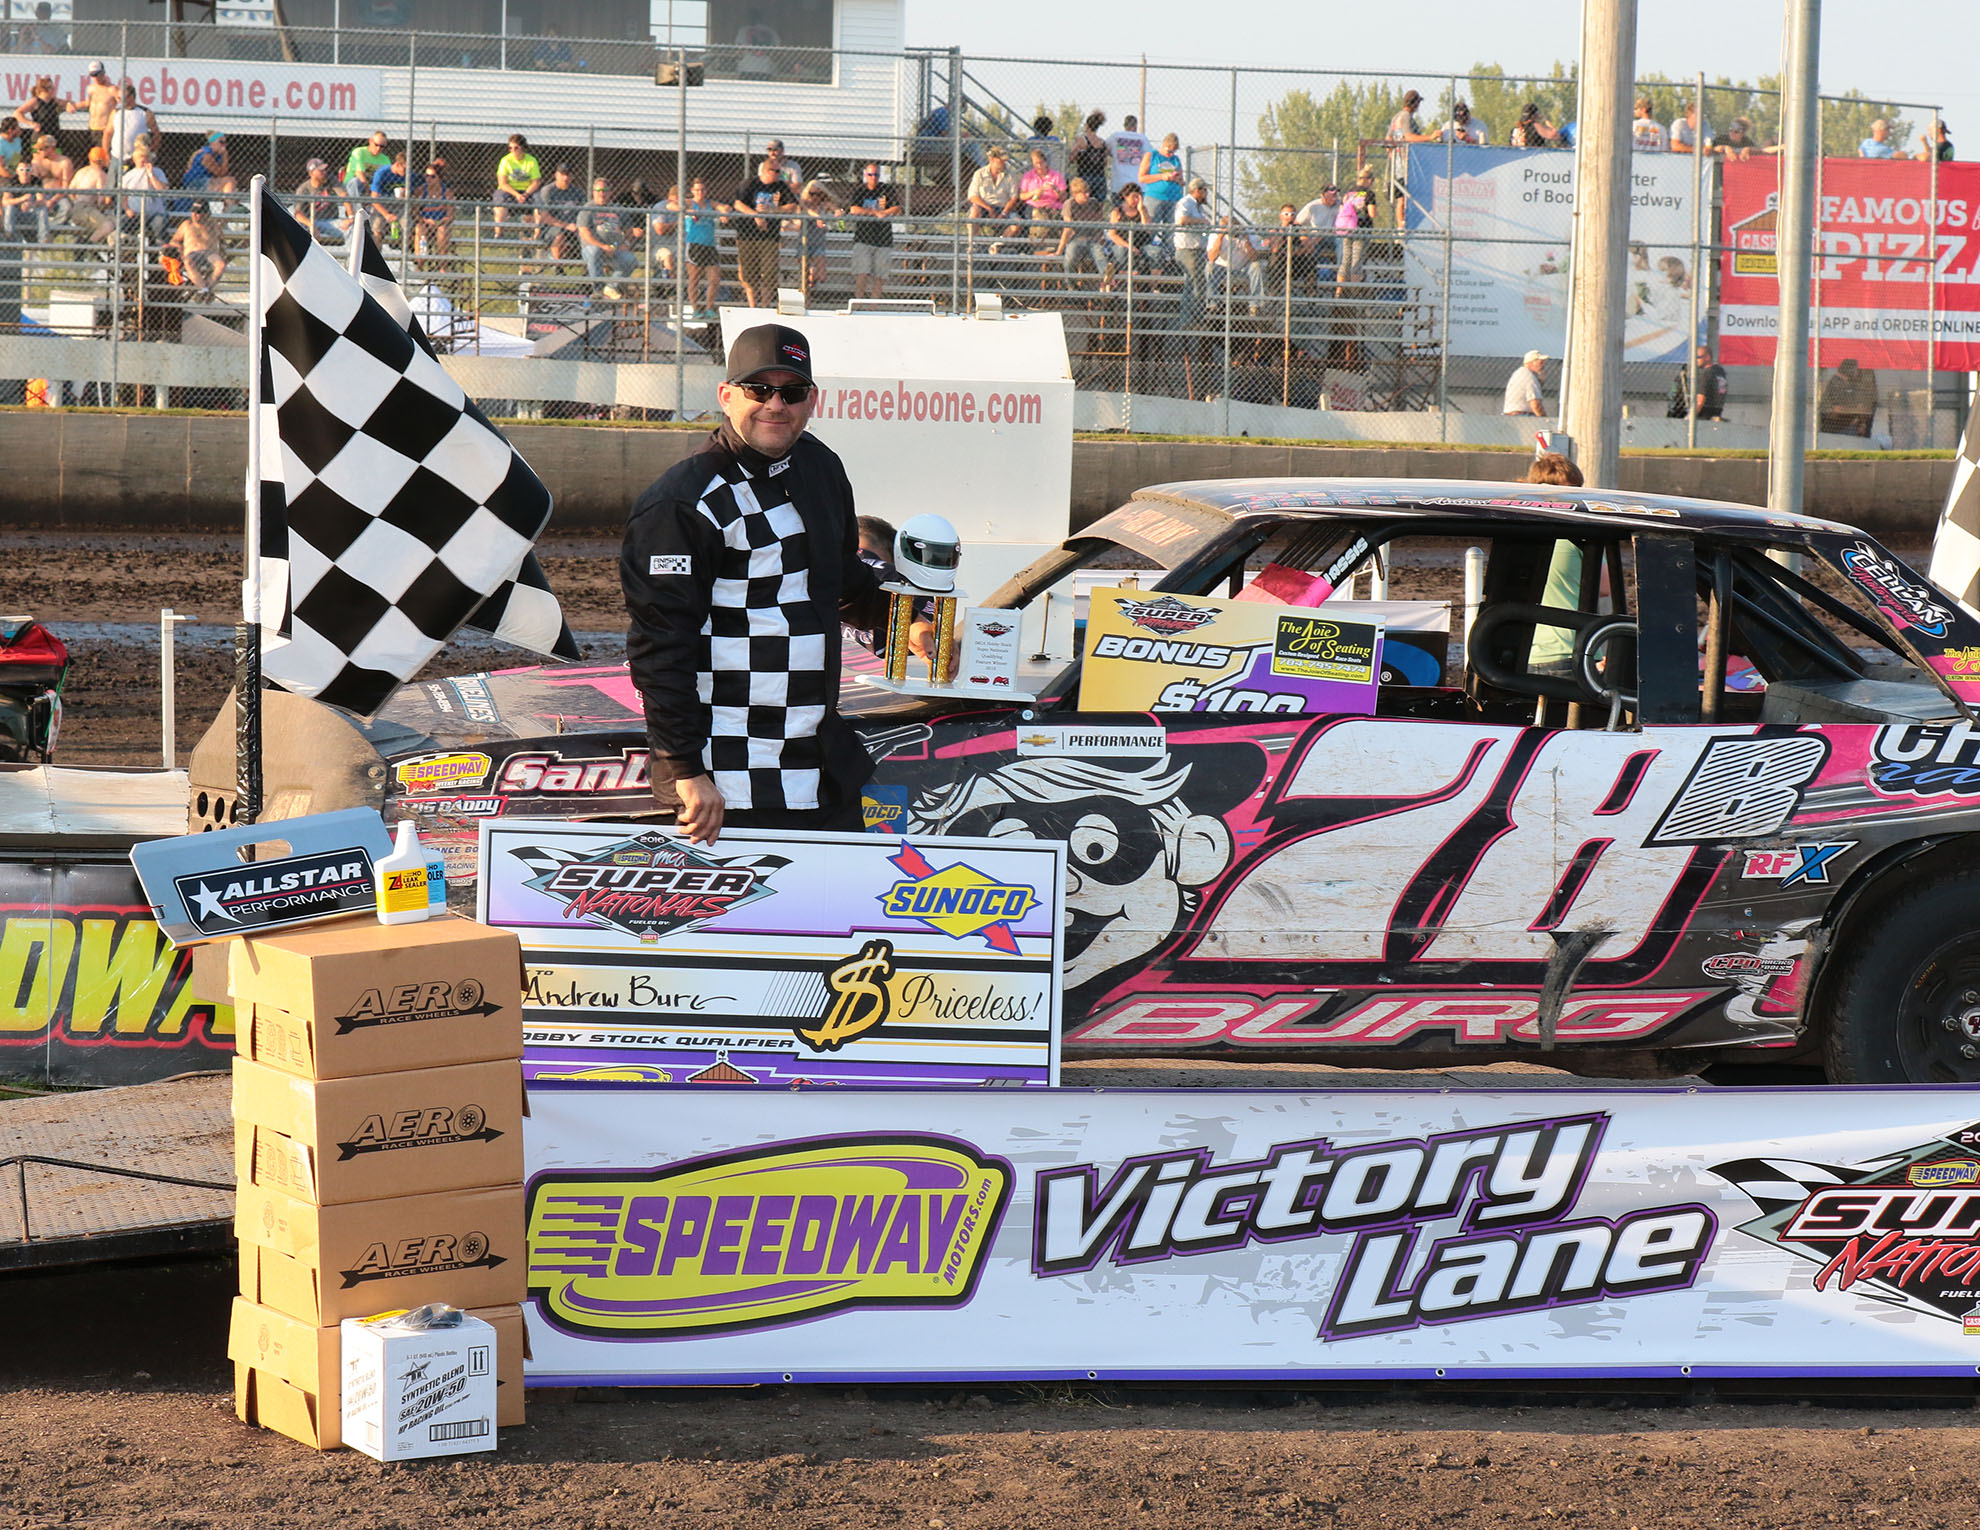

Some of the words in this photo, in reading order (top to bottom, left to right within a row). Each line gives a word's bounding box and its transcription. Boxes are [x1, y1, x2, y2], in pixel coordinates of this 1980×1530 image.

[1523, 168, 1571, 185] Proud
[1523, 188, 1540, 204] of
[1544, 190, 1574, 205] Boo
[1631, 193, 1683, 211] edway
[1820, 196, 1968, 227] FAMOUS
[1818, 231, 1980, 284] PIZZ
[1727, 314, 1778, 328] Downlo
[1823, 317, 1850, 329] APP
[1854, 318, 1879, 331] and
[1882, 318, 1928, 332] ORDER
[1129, 606, 1207, 622] SUPER
[1280, 621, 1302, 633] The
[1093, 634, 1232, 669] BONUS
[1309, 639, 1326, 654] of
[1321, 639, 1372, 659] Seating
[1068, 734, 1164, 748] PERFORMANCE
[416, 760, 483, 779] SPEEDWAY
[438, 799, 501, 816] DADDY
[427, 870, 444, 881] OLER
[1745, 841, 1858, 887] RFX
[222, 861, 363, 901] ALLSTAR
[554, 868, 750, 893] SUPER
[230, 884, 373, 917] PERFORMANCE
[562, 887, 736, 919] NATIONALS
[889, 886, 1029, 916] SUNOCO
[345, 977, 485, 1018] AERO
[522, 975, 620, 1007] Andrew
[898, 972, 1043, 1021] Priceless!
[379, 1014, 412, 1025] RACE
[415, 1009, 461, 1020] WHEELS
[1066, 990, 1722, 1042] BURG
[523, 1032, 583, 1043] OBBY
[588, 1033, 669, 1045] STOCK
[675, 1036, 795, 1048] QUALIFIER
[347, 1103, 487, 1143] AERO
[381, 1140, 414, 1150] RACE
[416, 1135, 462, 1146] WHEELS
[1922, 1167, 1976, 1180] SPEEDWAY
[1038, 1117, 1602, 1270] Victory
[614, 1193, 969, 1277] SPEEDWAY
[943, 1178, 993, 1287] MOTORS.com
[350, 1230, 490, 1271] AERO
[384, 1268, 417, 1278] RACE
[420, 1262, 465, 1273] WHEELS
[1332, 1209, 1710, 1331] Lane
[401, 1377, 441, 1405] SYNTHETIC
[442, 1364, 465, 1384] BLEND
[408, 1410, 434, 1430] RACING
